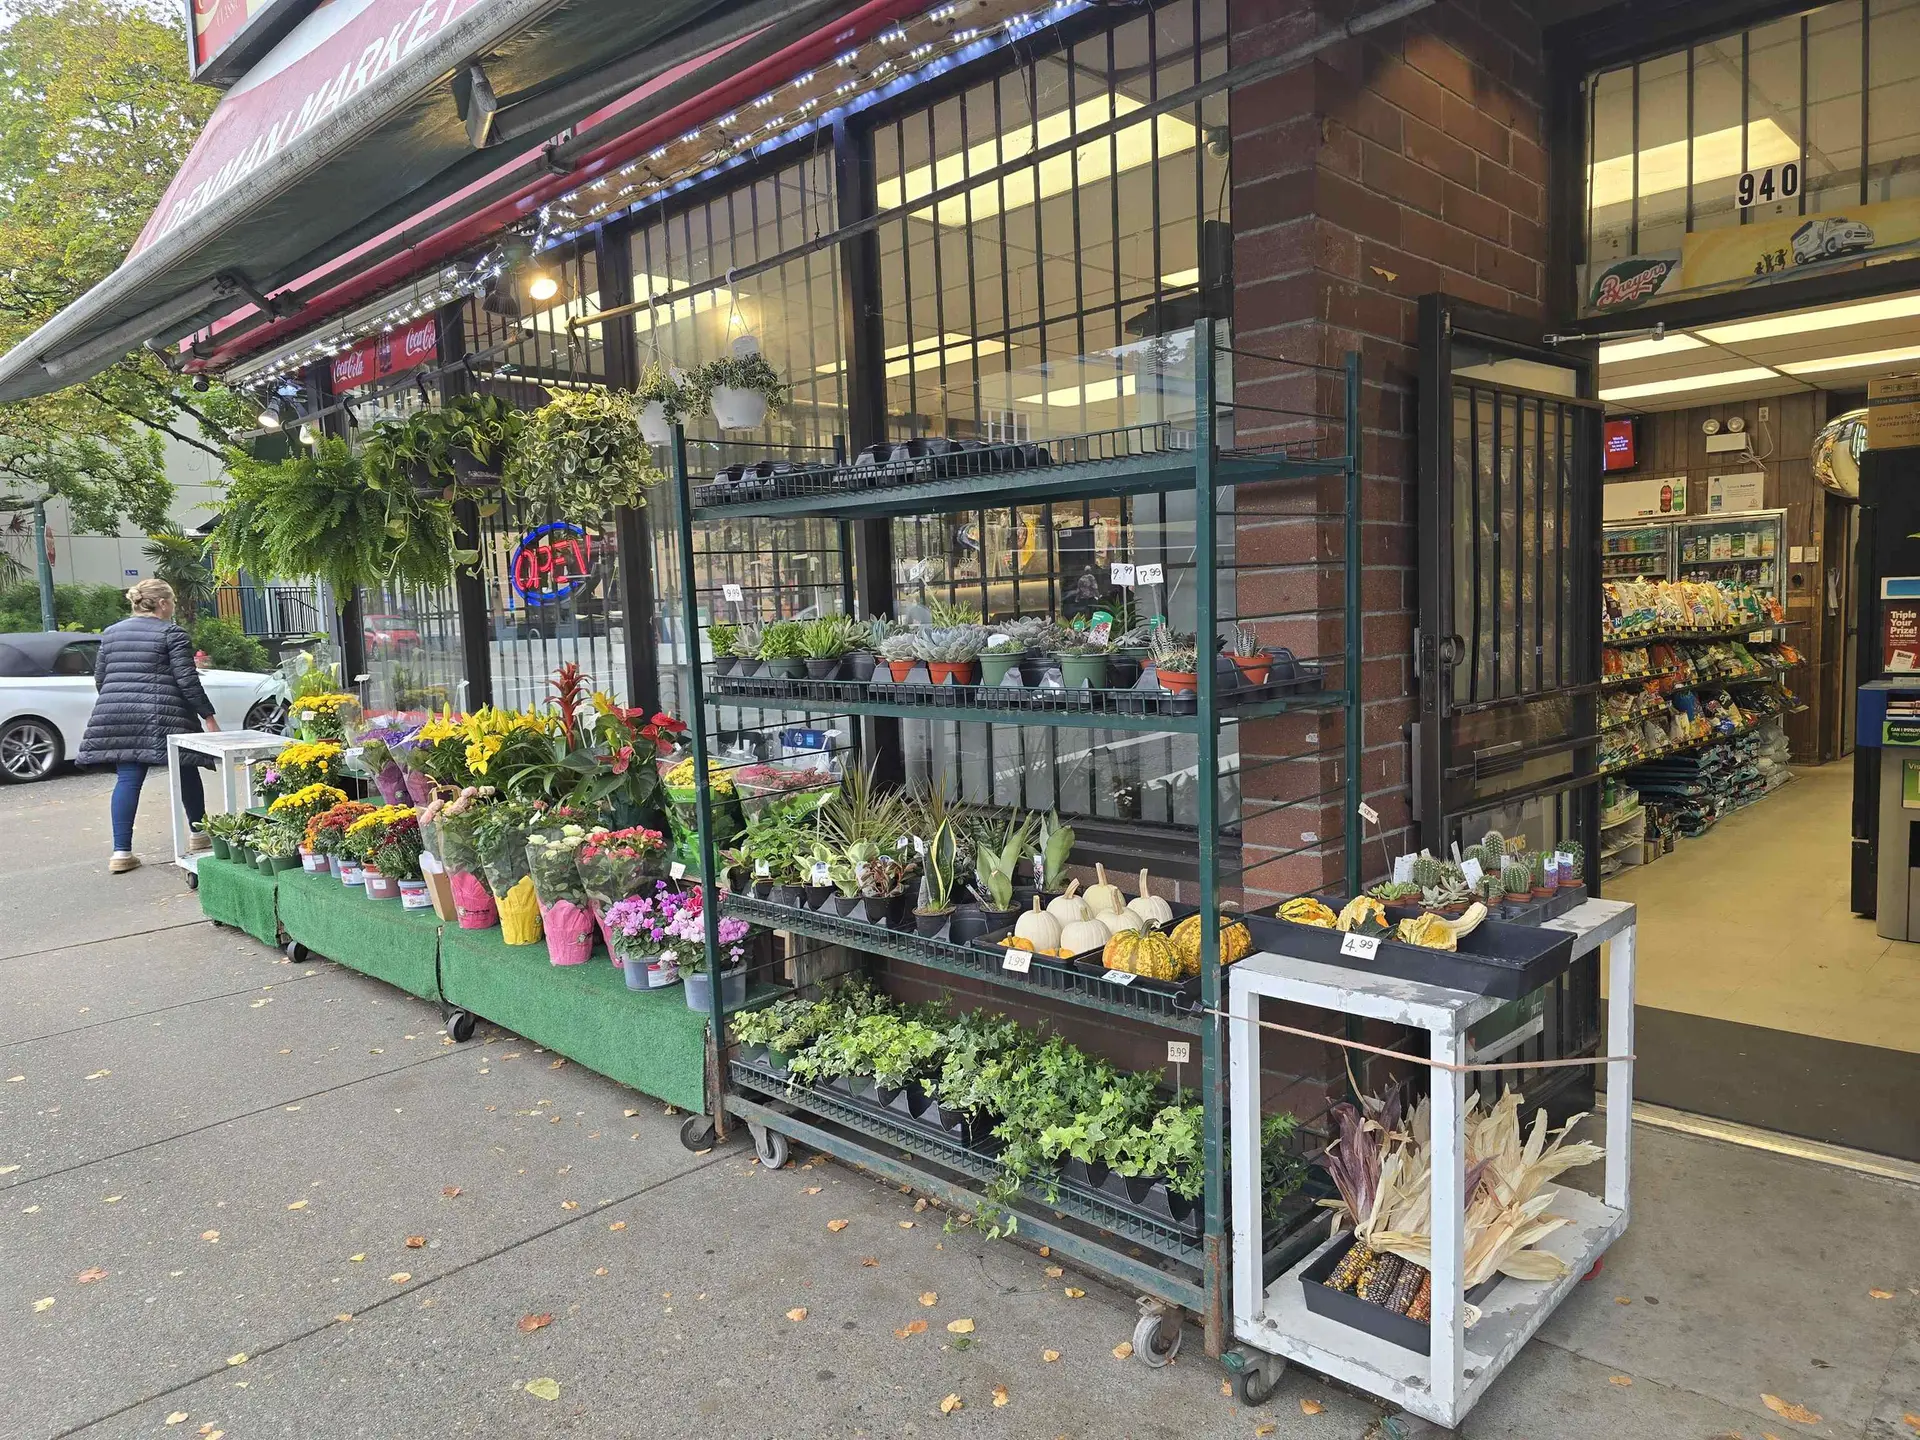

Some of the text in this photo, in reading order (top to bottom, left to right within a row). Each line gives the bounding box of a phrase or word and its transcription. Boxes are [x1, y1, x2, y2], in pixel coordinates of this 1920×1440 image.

[160, 110, 294, 238] DENMAN
[1738, 163, 1798, 206] 940
[1597, 262, 1667, 309] Breyers
[406, 319, 436, 357] Coca-Col
[515, 535, 591, 590] OPEN
[1112, 565, 1133, 580] 9.99
[1140, 567, 1161, 583] 7.99
[1890, 610, 1917, 620] Triple
[1890, 618, 1912, 627] Your
[1890, 626, 1918, 634] Prize!
[1344, 938, 1374, 953] 4.99
[1008, 954, 1026, 968] 1.99
